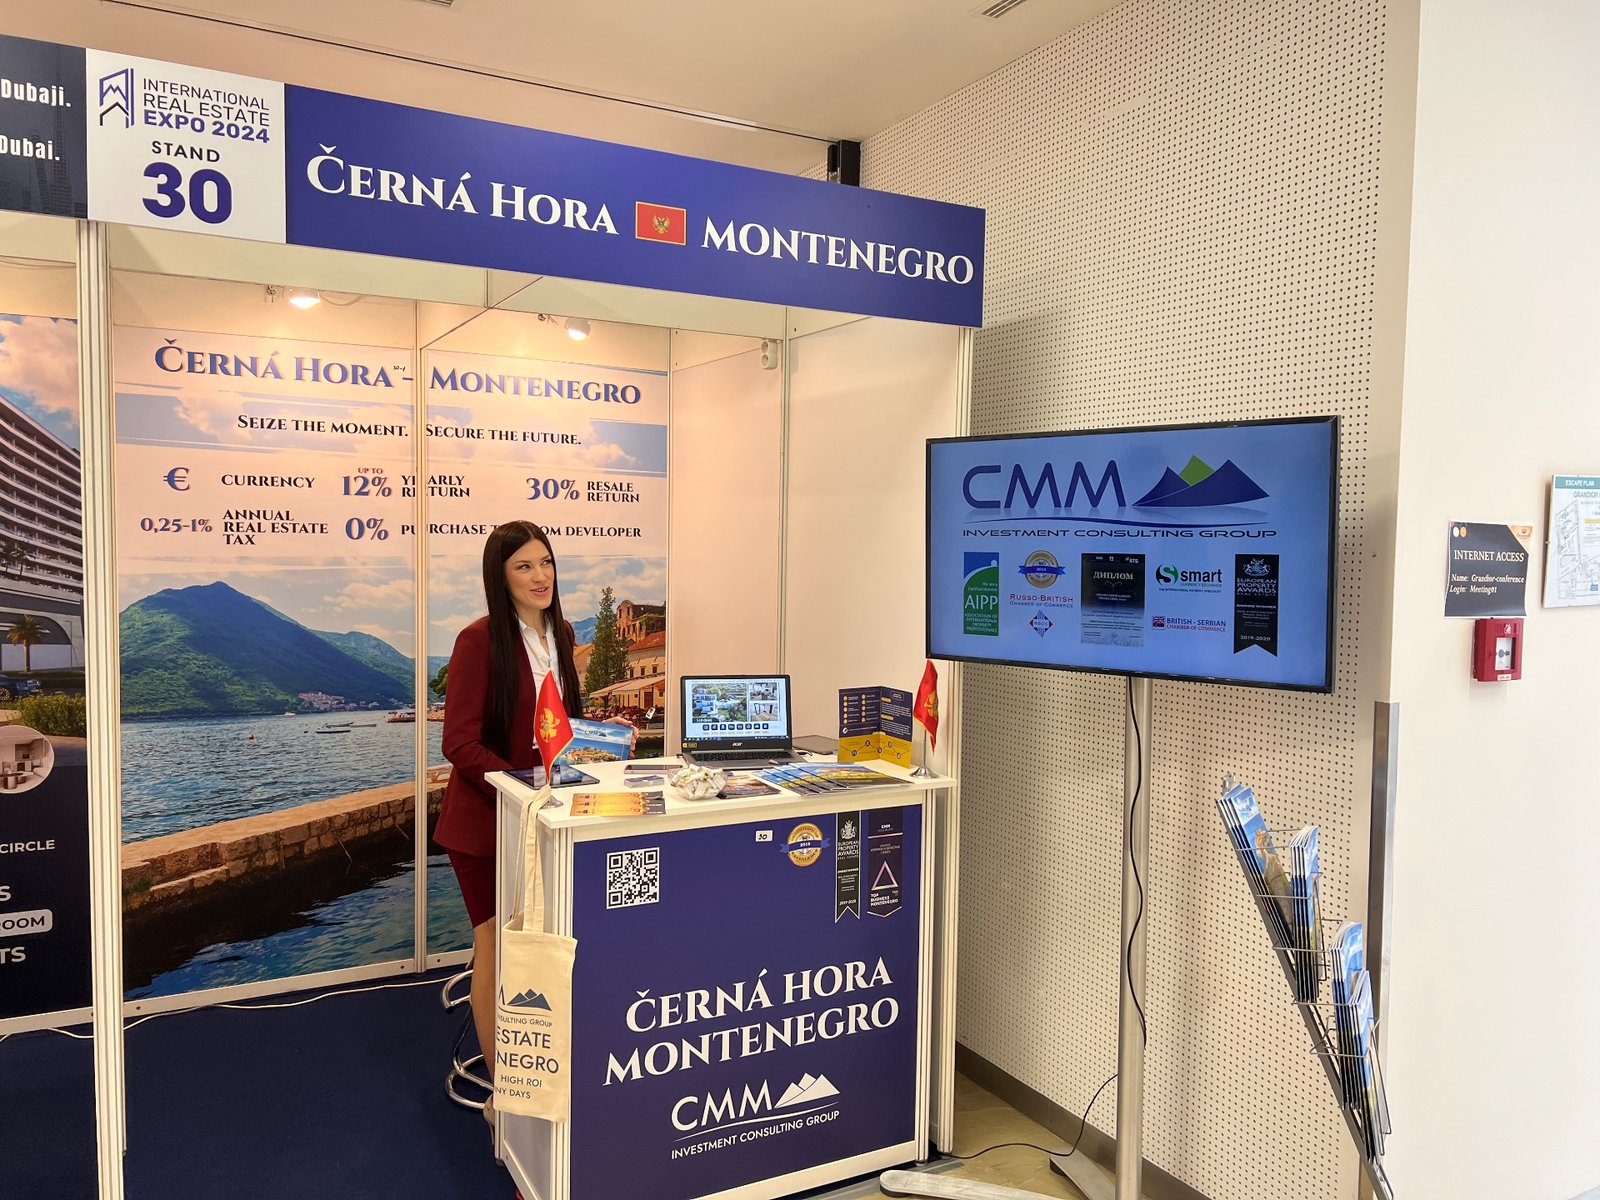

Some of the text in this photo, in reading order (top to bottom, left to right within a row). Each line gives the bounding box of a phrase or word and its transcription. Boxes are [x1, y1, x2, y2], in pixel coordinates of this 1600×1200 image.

[1, 78, 72, 107] Dubaji.
[143, 78, 269, 110] INTERNATIONAL
[143, 93, 270, 127] REAL ESTATE
[144, 109, 270, 143] EXPO 2024
[0, 134, 60, 161] Dubai.
[152, 140, 220, 162] STAND
[142, 161, 232, 224] 30
[306, 144, 974, 286] ČERNÁ HORA MONTENEGRO
[154, 338, 283, 380] ČERNÁ
[294, 355, 393, 388] HORA
[430, 366, 641, 405] MONTENEGRO
[237, 415, 581, 445] SEIZE THE MOMENT. SECURE THE FUTURE.
[370, 467, 383, 475] TO
[221, 474, 315, 489] CURRENCY
[342, 475, 392, 498] 12%
[526, 477, 580, 501] 30%
[587, 481, 633, 492] RESALE
[962, 459, 1127, 509] CMM
[587, 492, 640, 503] RETURN
[222, 509, 294, 521] ANNUAL
[140, 517, 212, 533] 0,25-1%
[223, 522, 328, 534] REAL ESTATE
[345, 517, 389, 541] 0%
[565, 526, 642, 538] DEVELOPER
[223, 534, 255, 545] TAX
[962, 529, 1277, 539] INVESTMENT CONSULTING GROUP
[1454, 550, 1524, 562] INTERNET ACCESS
[1093, 571, 1134, 580] ДИПЛОМ
[1180, 568, 1222, 583] smart
[1451, 574, 1525, 583] Name: Grandior-conference
[1449, 585, 1467, 595] Login:
[964, 594, 998, 610] AIPP
[1166, 617, 1192, 625] BRITISH
[1197, 619, 1226, 627] SERBIAN
[0, 840, 55, 854] CIRCLE
[0, 915, 45, 931] OOM
[625, 956, 894, 1033] ČERNÁ HORA
[530, 1018, 553, 1027] GROUP
[602, 997, 900, 1087] MONTENEGRO
[500, 1074, 542, 1088] HIGH ROI
[510, 1089, 531, 1099] DAYS
[671, 1078, 773, 1131] CMM
[671, 1110, 840, 1160] INVESTMENT CONSULTING GROUP
